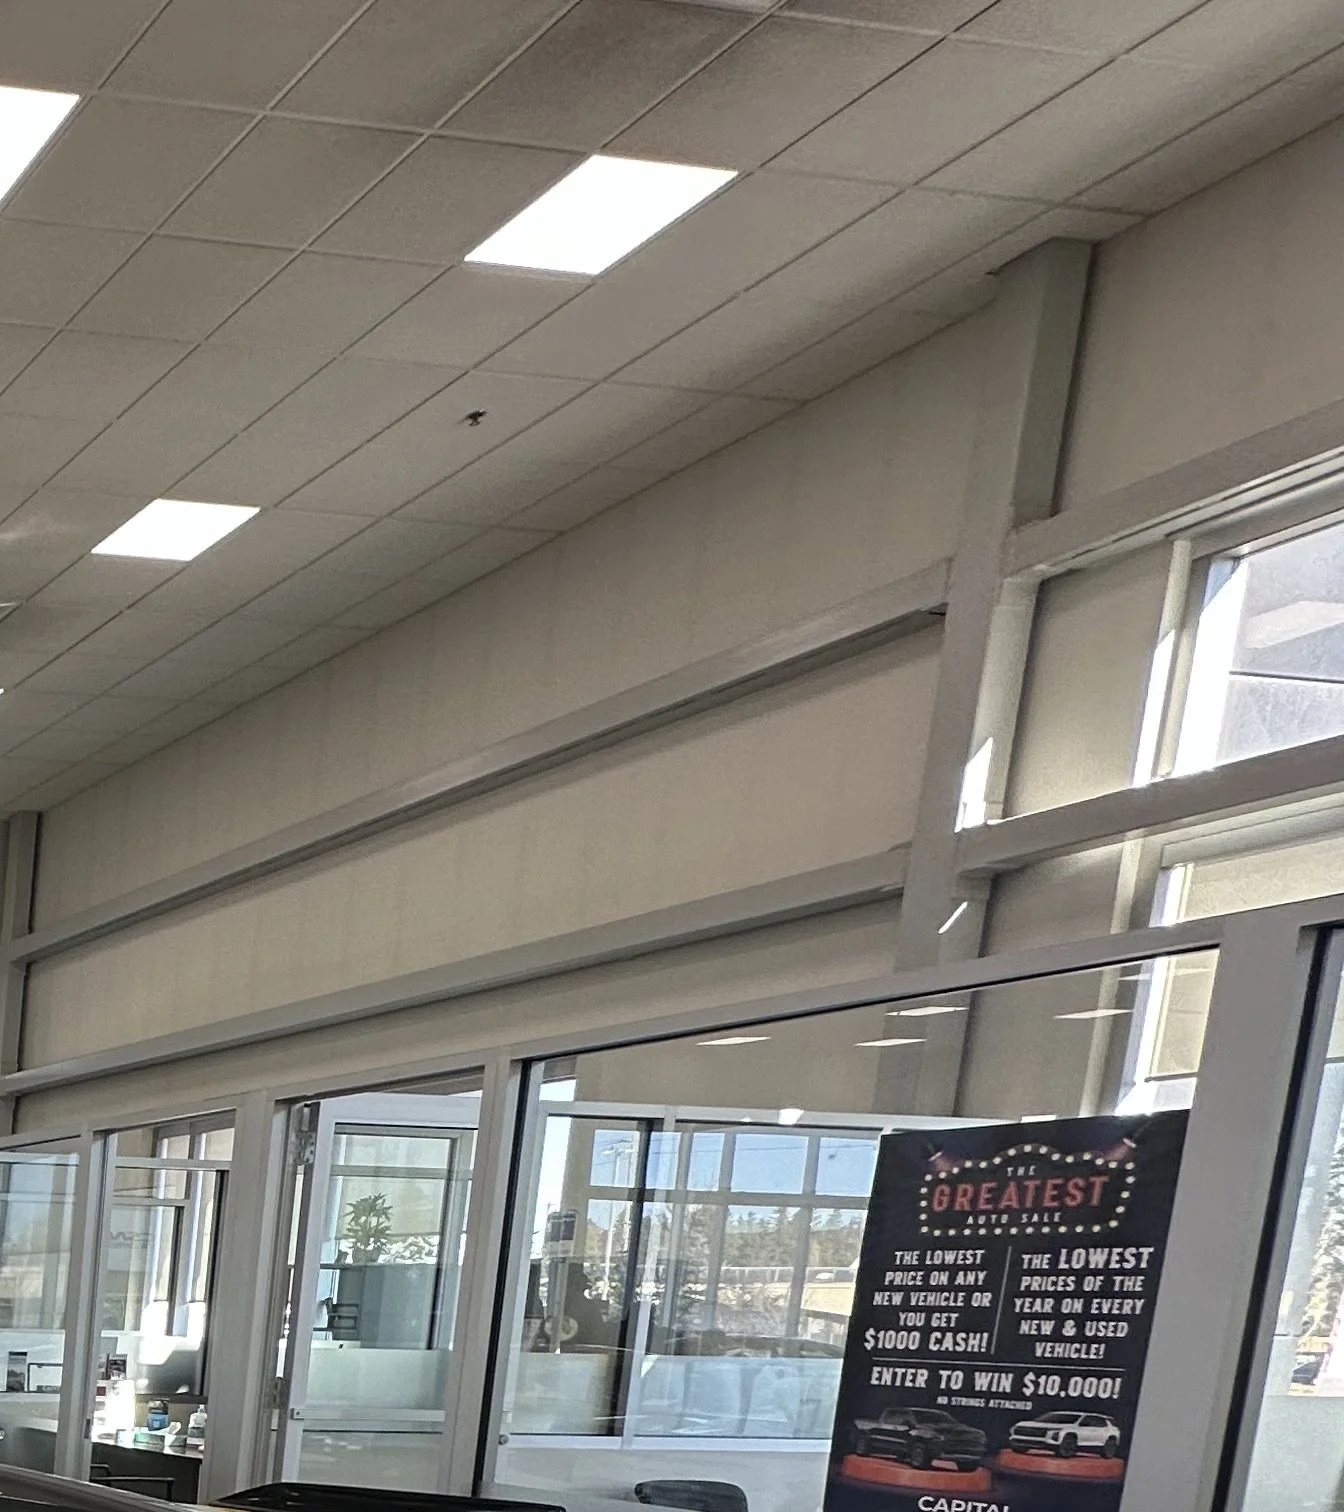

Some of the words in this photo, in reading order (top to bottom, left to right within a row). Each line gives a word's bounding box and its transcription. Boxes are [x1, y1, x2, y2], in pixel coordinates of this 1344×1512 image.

[1006, 1165, 1037, 1177] THE
[931, 1175, 1111, 1213] GREATEST
[966, 1214, 1009, 1225] AUTO
[1021, 1212, 1062, 1223] SALE
[894, 1250, 921, 1265] THE
[925, 1249, 985, 1265] LOWEST
[1021, 1254, 1052, 1269] THE
[1057, 1247, 1155, 1269] LOWEST
[884, 1271, 925, 1286] PRICE
[929, 1271, 950, 1286] ON
[954, 1270, 988, 1286] ANY
[1020, 1276, 1076, 1292] PRICES
[1082, 1276, 1105, 1292] OF
[1113, 1276, 1145, 1292] THE
[872, 1291, 905, 1306] NEW
[910, 1291, 966, 1307] VEHICLE
[971, 1292, 992, 1307] OR
[1014, 1298, 1054, 1313] YEAR
[1060, 1298, 1085, 1314] ON
[1090, 1298, 1145, 1315] EVERY
[899, 1312, 926, 1327] YOU
[931, 1312, 960, 1328] GET
[1019, 1319, 1056, 1335] NEW
[1062, 1319, 1077, 1337] &
[1084, 1321, 1129, 1338] USED
[863, 1327, 921, 1351] $1000
[928, 1331, 989, 1353] CASH!
[1035, 1341, 1106, 1359] VEHICLE!
[870, 1366, 929, 1388] ENTER
[938, 1369, 964, 1390] TO
[974, 1371, 1014, 1393] WIN
[936, 1396, 948, 1405] NO
[950, 1396, 986, 1408] STRINGS
[987, 1398, 1033, 1411] ATTACHED
